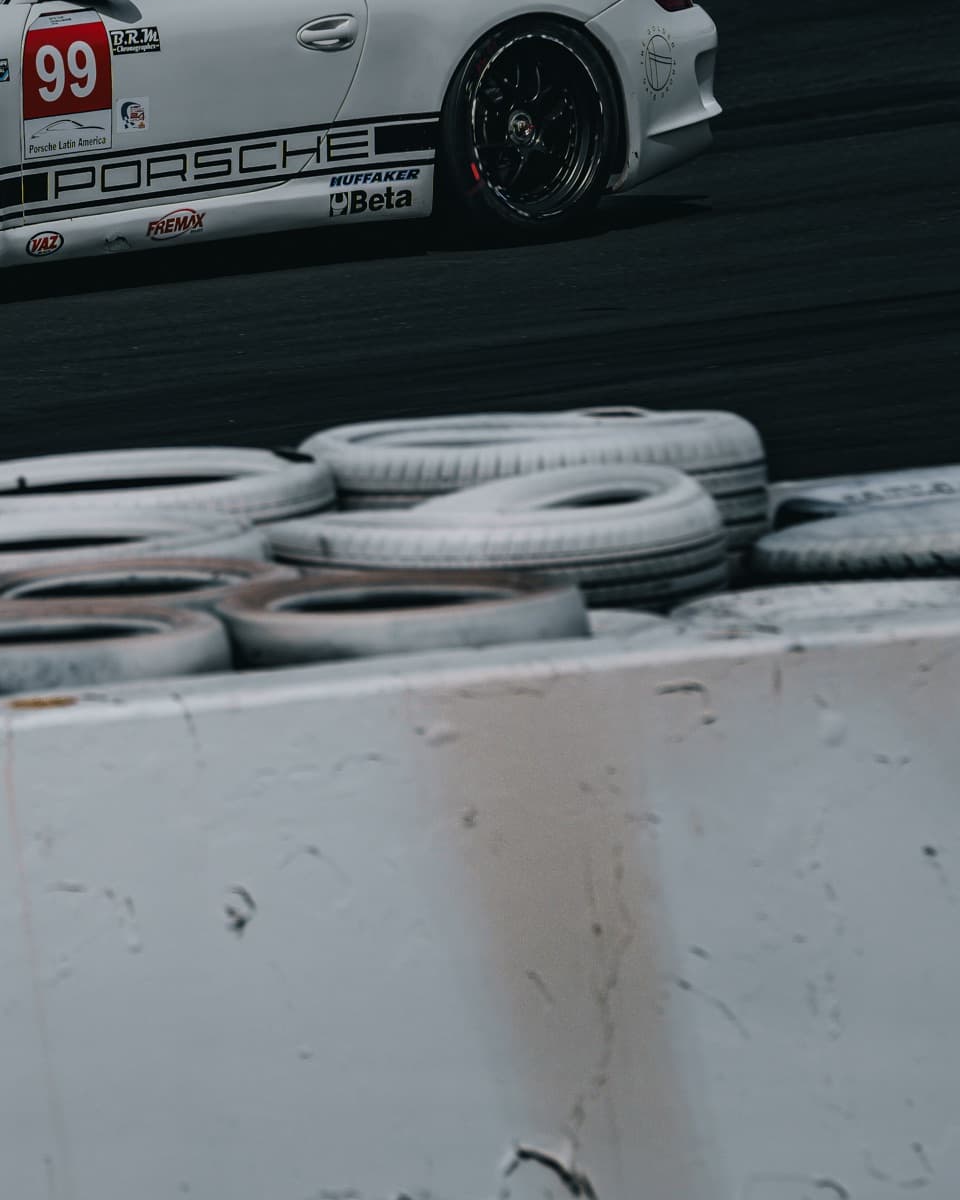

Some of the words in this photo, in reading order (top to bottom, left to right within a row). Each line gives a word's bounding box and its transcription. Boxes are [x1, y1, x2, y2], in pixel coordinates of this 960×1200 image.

[35, 40, 97, 102] 99
[29, 142, 57, 154] Porsche
[58, 139, 76, 150] Latin
[78, 136, 106, 147] America
[53, 129, 369, 200] PORSCHE
[329, 168, 420, 187] HUFFAKER
[350, 186, 412, 214] Beta
[146, 212, 207, 237] FREMAX
[31, 234, 59, 252] VAZ
